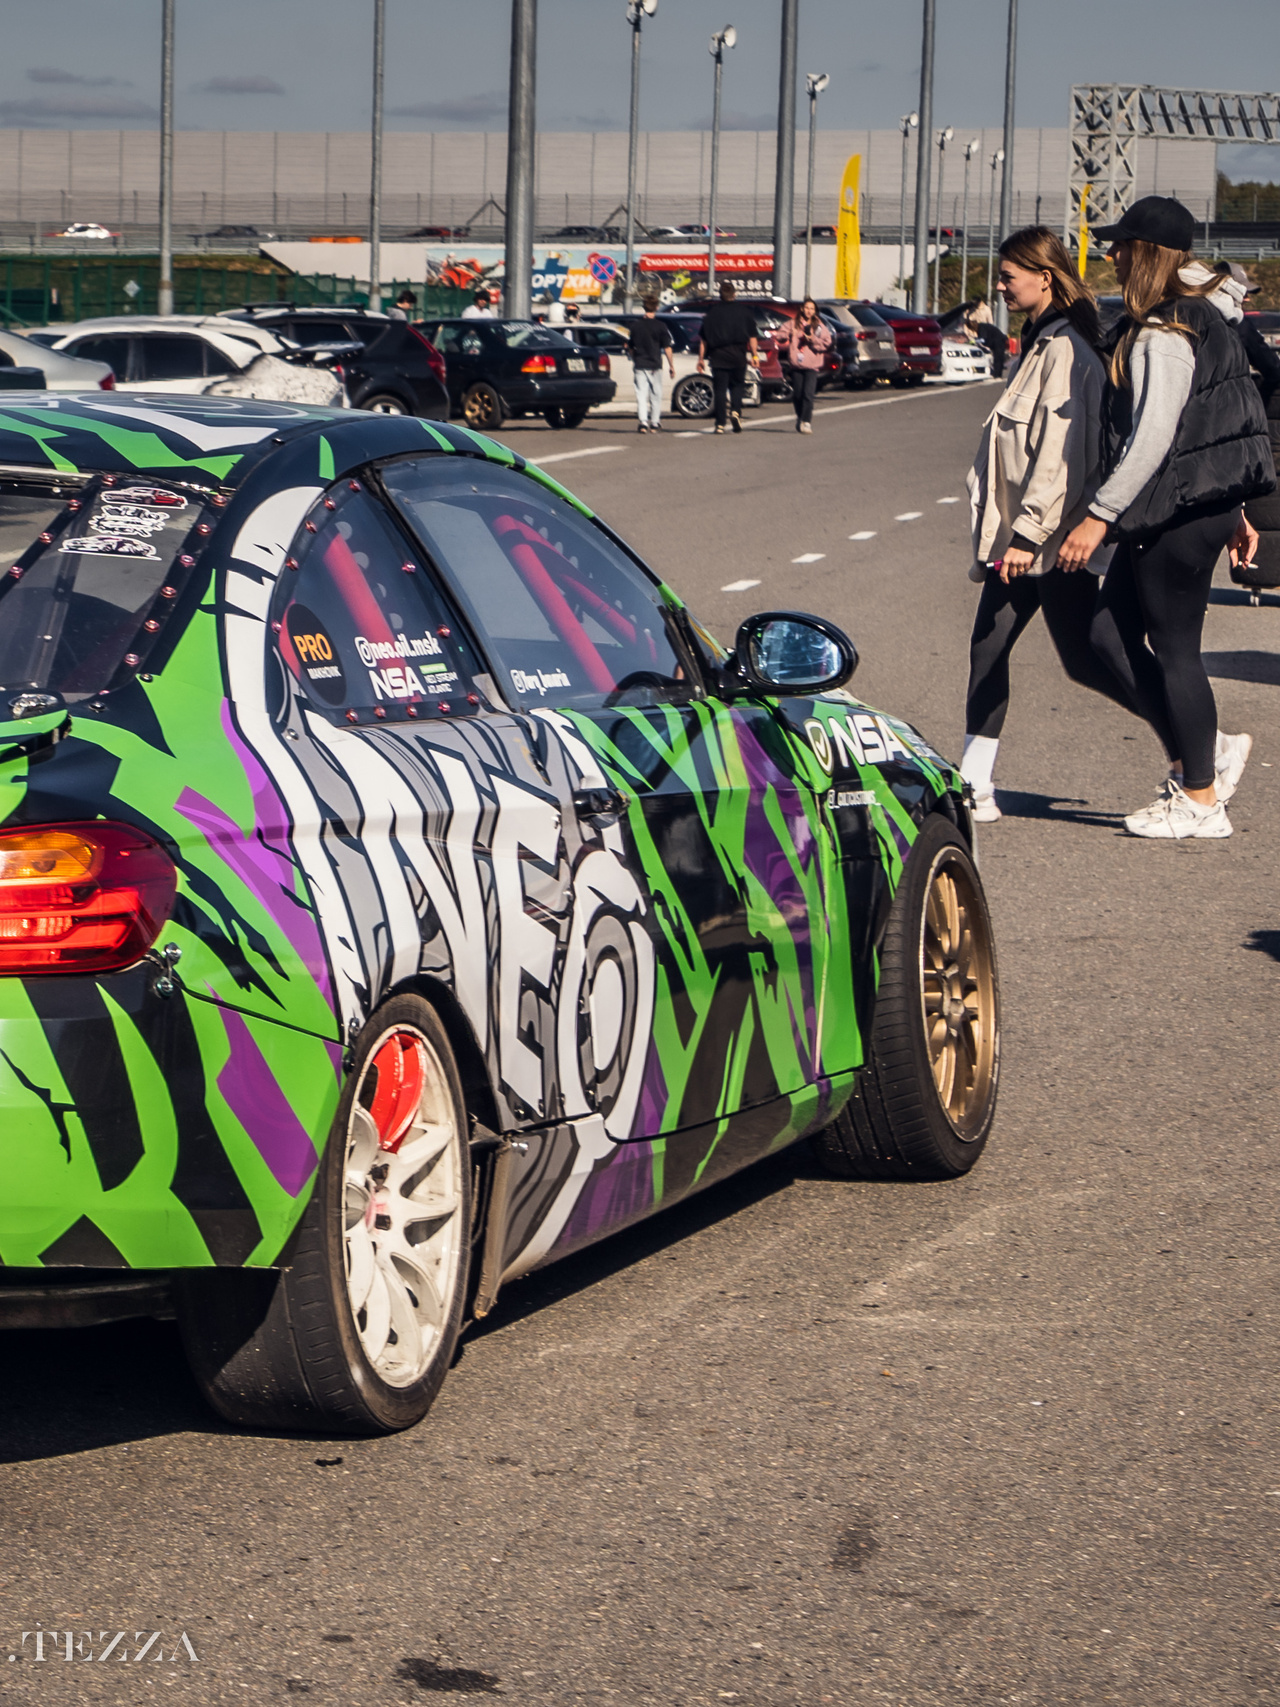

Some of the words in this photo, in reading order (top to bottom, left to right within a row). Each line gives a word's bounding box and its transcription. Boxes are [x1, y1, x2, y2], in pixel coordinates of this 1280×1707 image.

[293, 633, 333, 663] PRO
[354, 631, 442, 668] @neo.oil.msk
[369, 667, 427, 701] NSA
[828, 714, 913, 768] NSA
